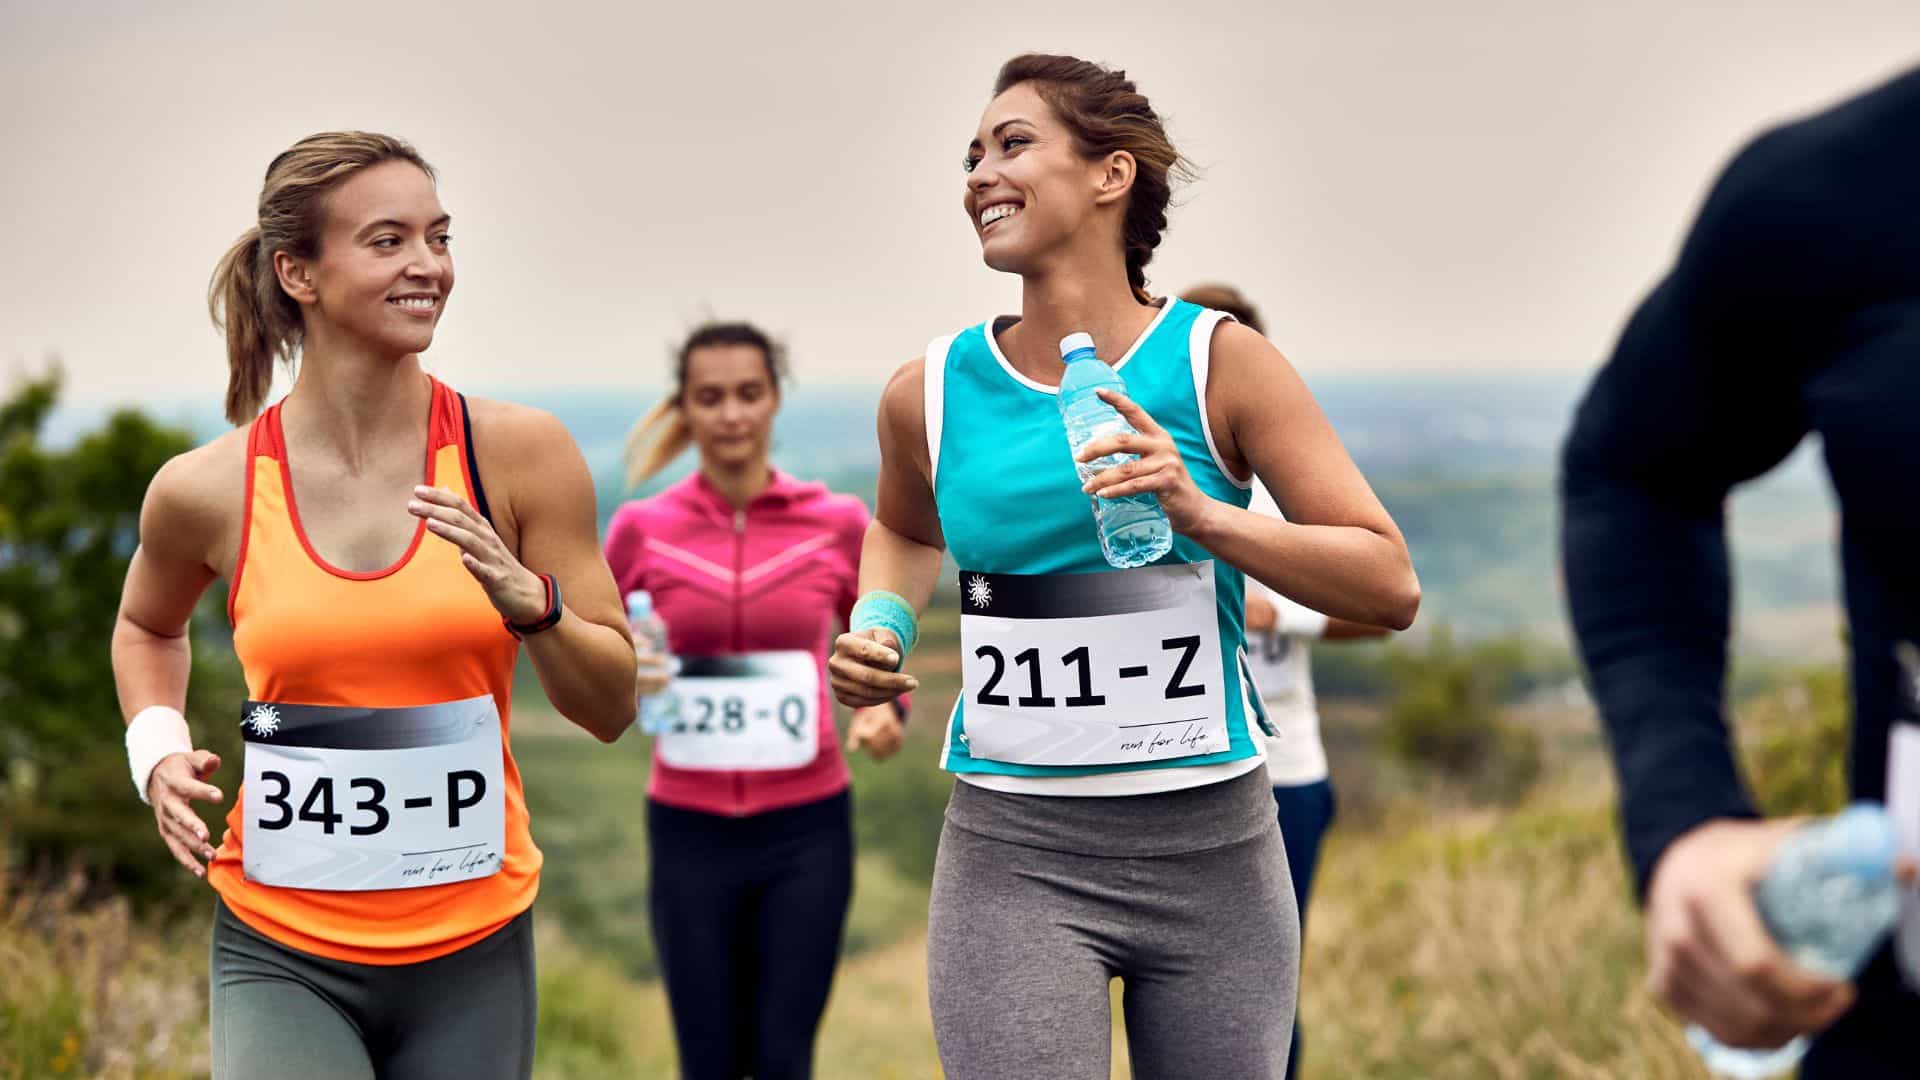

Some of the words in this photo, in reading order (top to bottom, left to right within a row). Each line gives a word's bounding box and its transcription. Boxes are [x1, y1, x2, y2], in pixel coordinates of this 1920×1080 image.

[1147, 731, 1174, 754] for
[1180, 723, 1208, 749] life
[428, 858, 454, 880] for
[459, 849, 486, 873] life
